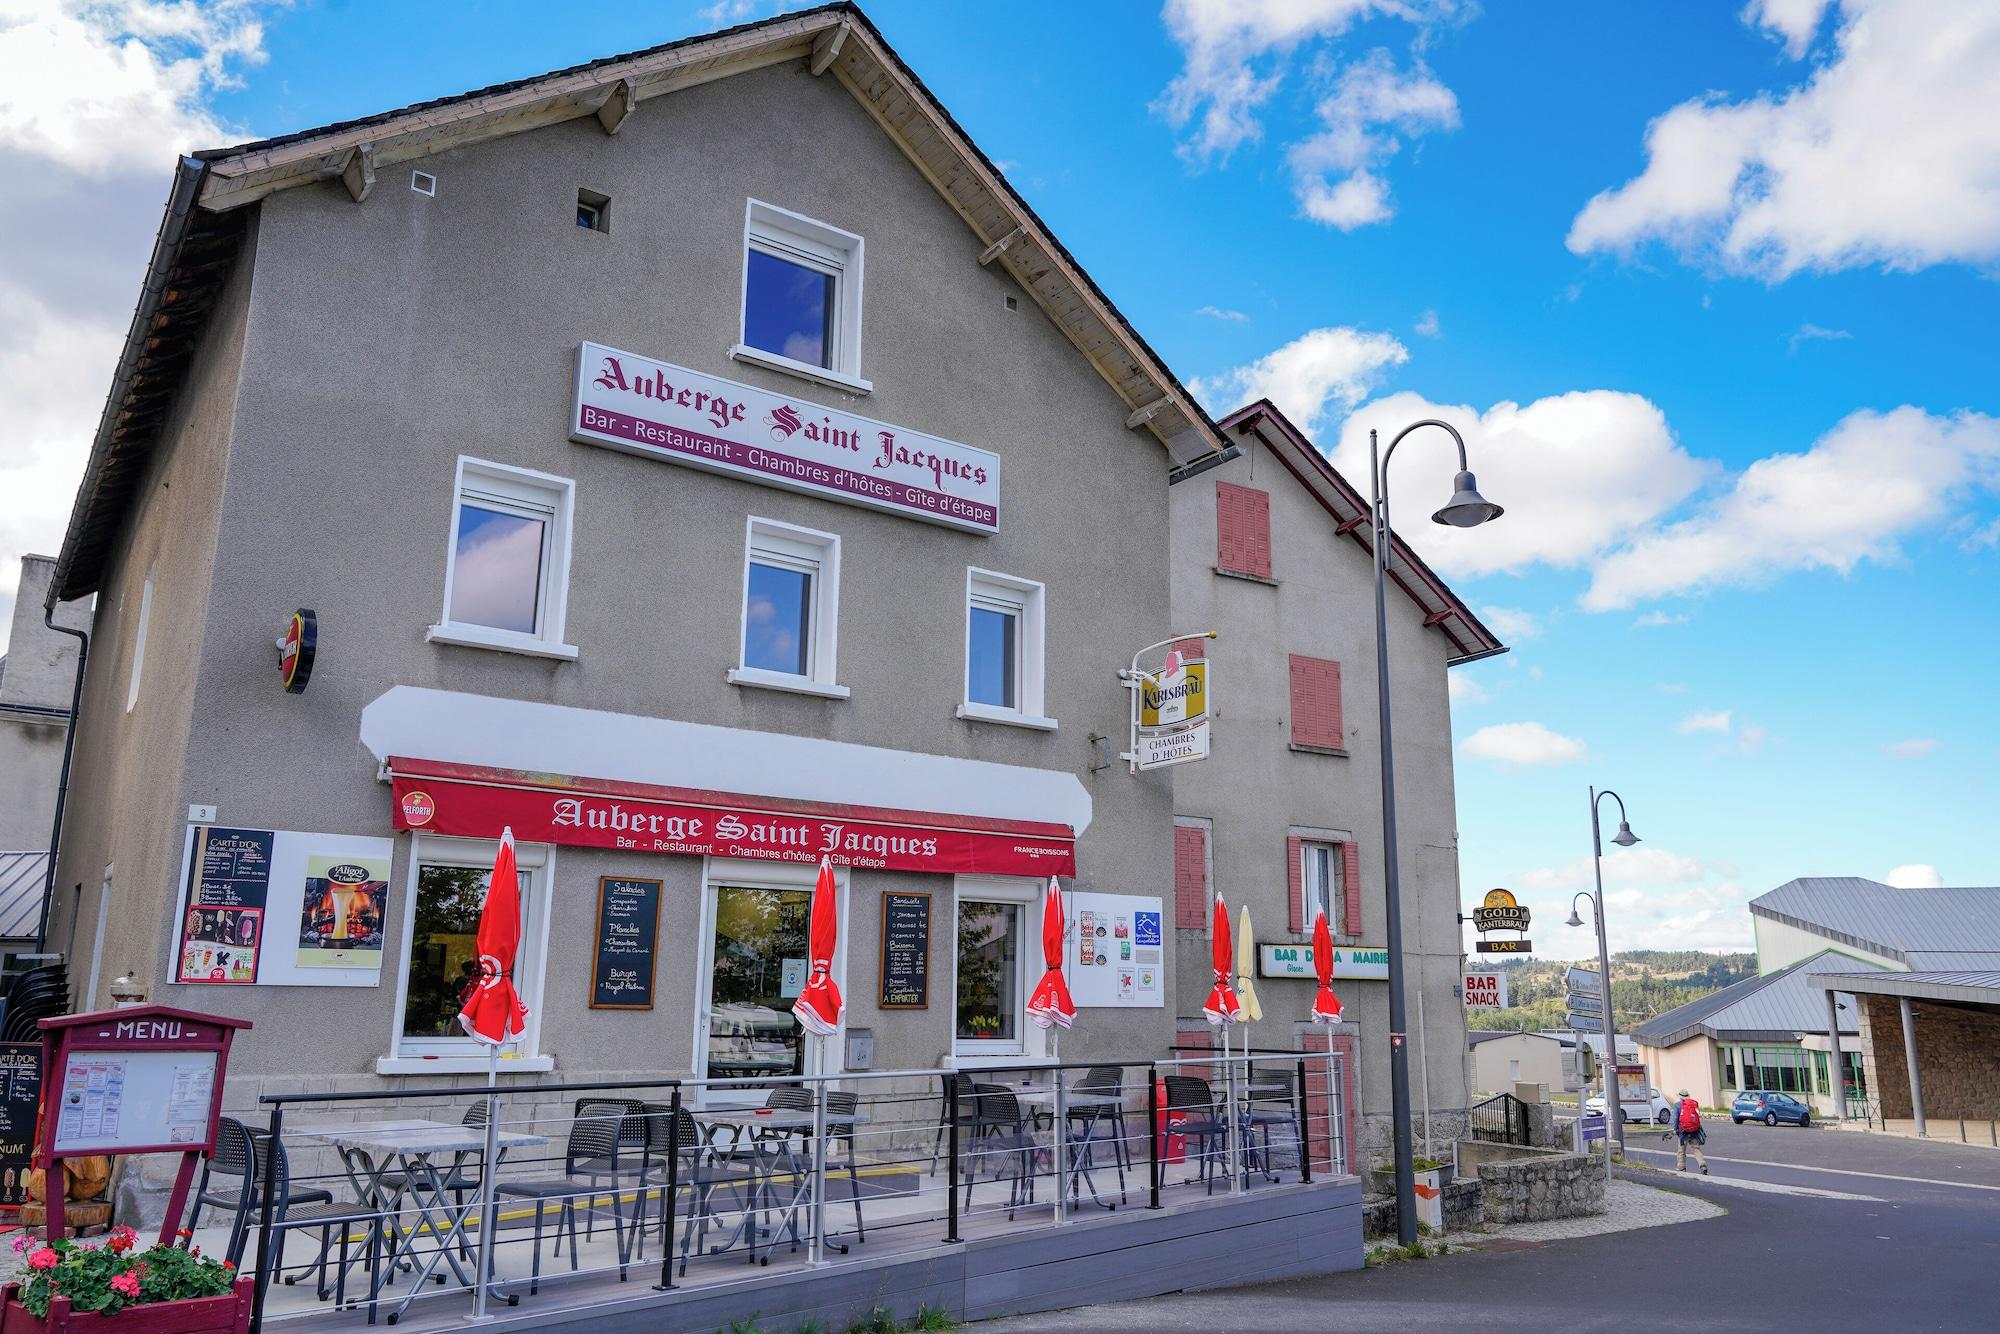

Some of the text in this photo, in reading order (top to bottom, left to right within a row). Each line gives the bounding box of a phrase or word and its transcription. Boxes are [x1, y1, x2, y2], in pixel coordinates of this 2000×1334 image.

[593, 356, 988, 493] Auberge Saint Jacques
[584, 408, 616, 432] Bar
[633, 420, 731, 459] Restaurant
[748, 449, 830, 484] Chambres
[834, 470, 892, 498] d'hôtes
[905, 487, 937, 509] Gîte
[939, 497, 993, 523] d'étape
[1149, 732, 1196, 751] CHAMBRES
[200, 809, 206, 818] 3
[403, 805, 431, 816] PELFORTH
[552, 798, 937, 857] Auberge Saint Jacques
[210, 838, 237, 848] CARTE
[240, 840, 262, 850] D'OR
[616, 836, 636, 849] Bar
[654, 839, 713, 854] Restaurant
[729, 845, 780, 860] Chambres
[783, 850, 817, 862] d'hôtes
[831, 854, 851, 865] Gîte
[853, 856, 886, 868] d'étape
[614, 882, 645, 895] Salades
[1483, 908, 1519, 918] GOLD
[1491, 942, 1518, 951] BAR
[1274, 948, 1298, 962] BAR
[1353, 952, 1389, 964] MAIRIE
[610, 968, 637, 981] Burger
[1286, 963, 1304, 973] Glaces
[605, 981, 625, 995] Royal
[1466, 976, 1497, 990] BAR
[891, 994, 919, 1004] EMPORTER
[1465, 992, 1500, 1006] SNACK
[115, 1021, 182, 1039] MENU
[17, 1054, 38, 1064] D'OR
